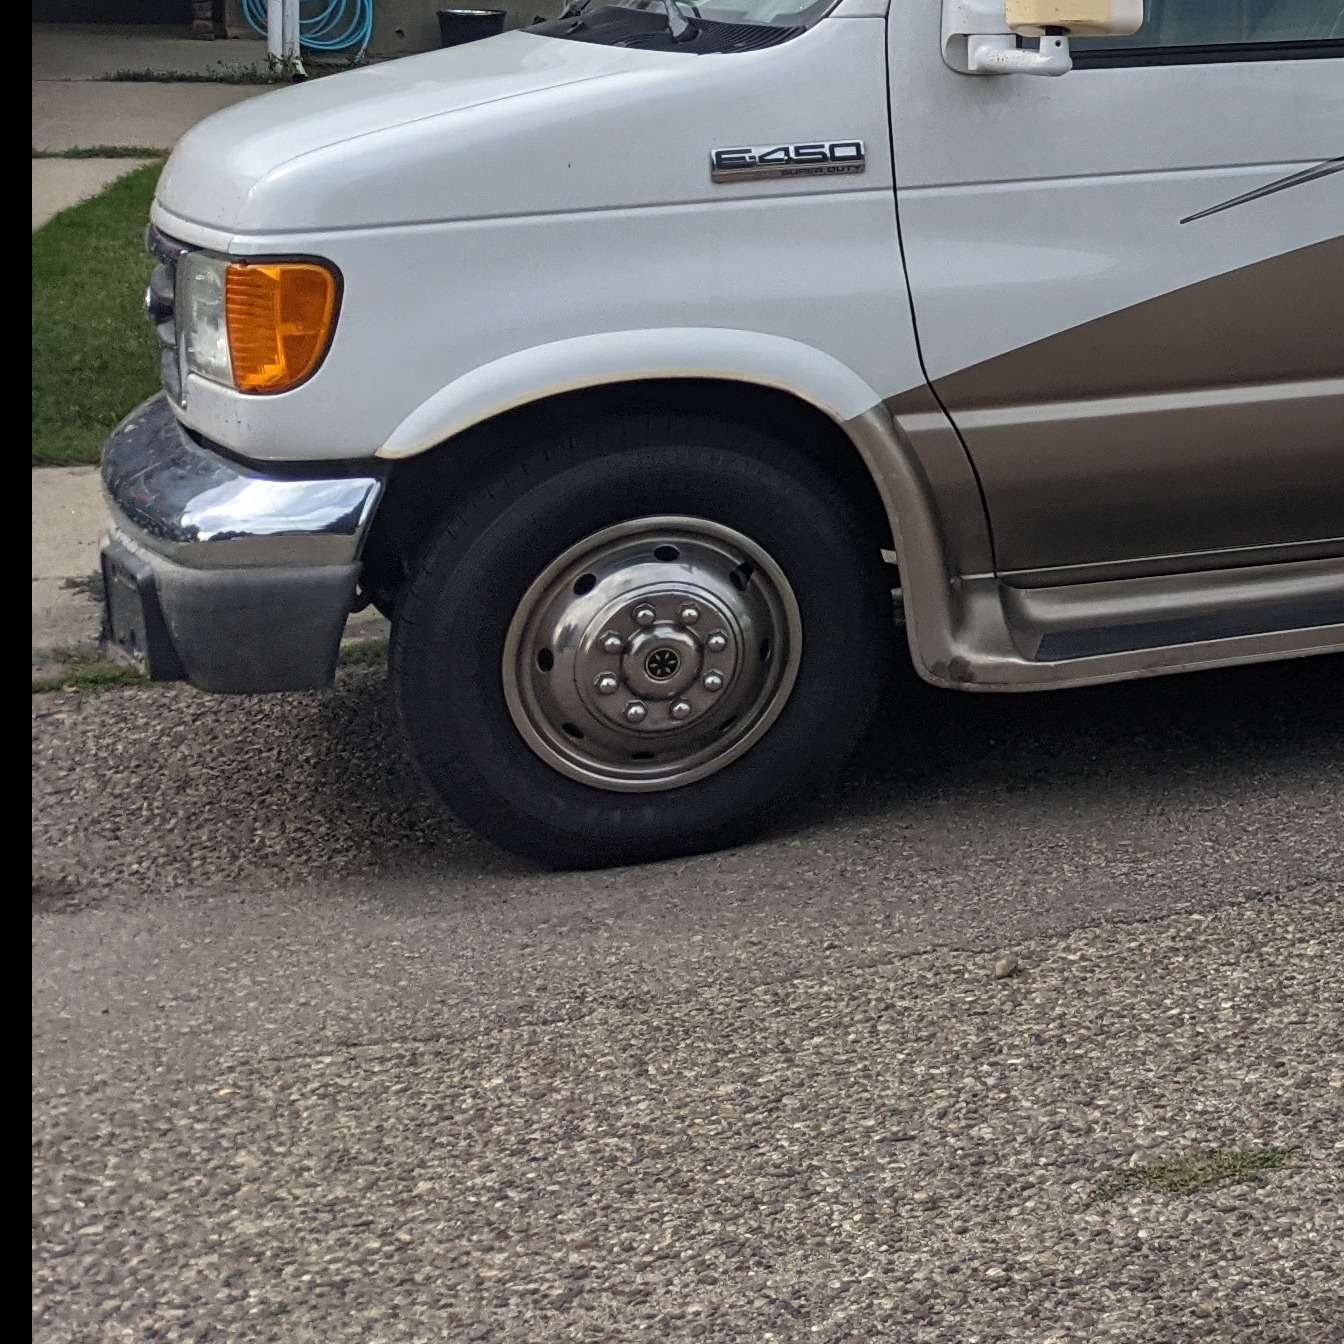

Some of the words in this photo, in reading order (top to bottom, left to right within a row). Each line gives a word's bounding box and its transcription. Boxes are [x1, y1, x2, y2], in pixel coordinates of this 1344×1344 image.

[714, 141, 864, 169] E-450
[781, 167, 823, 176] SUPER
[826, 164, 861, 173] DUTY
